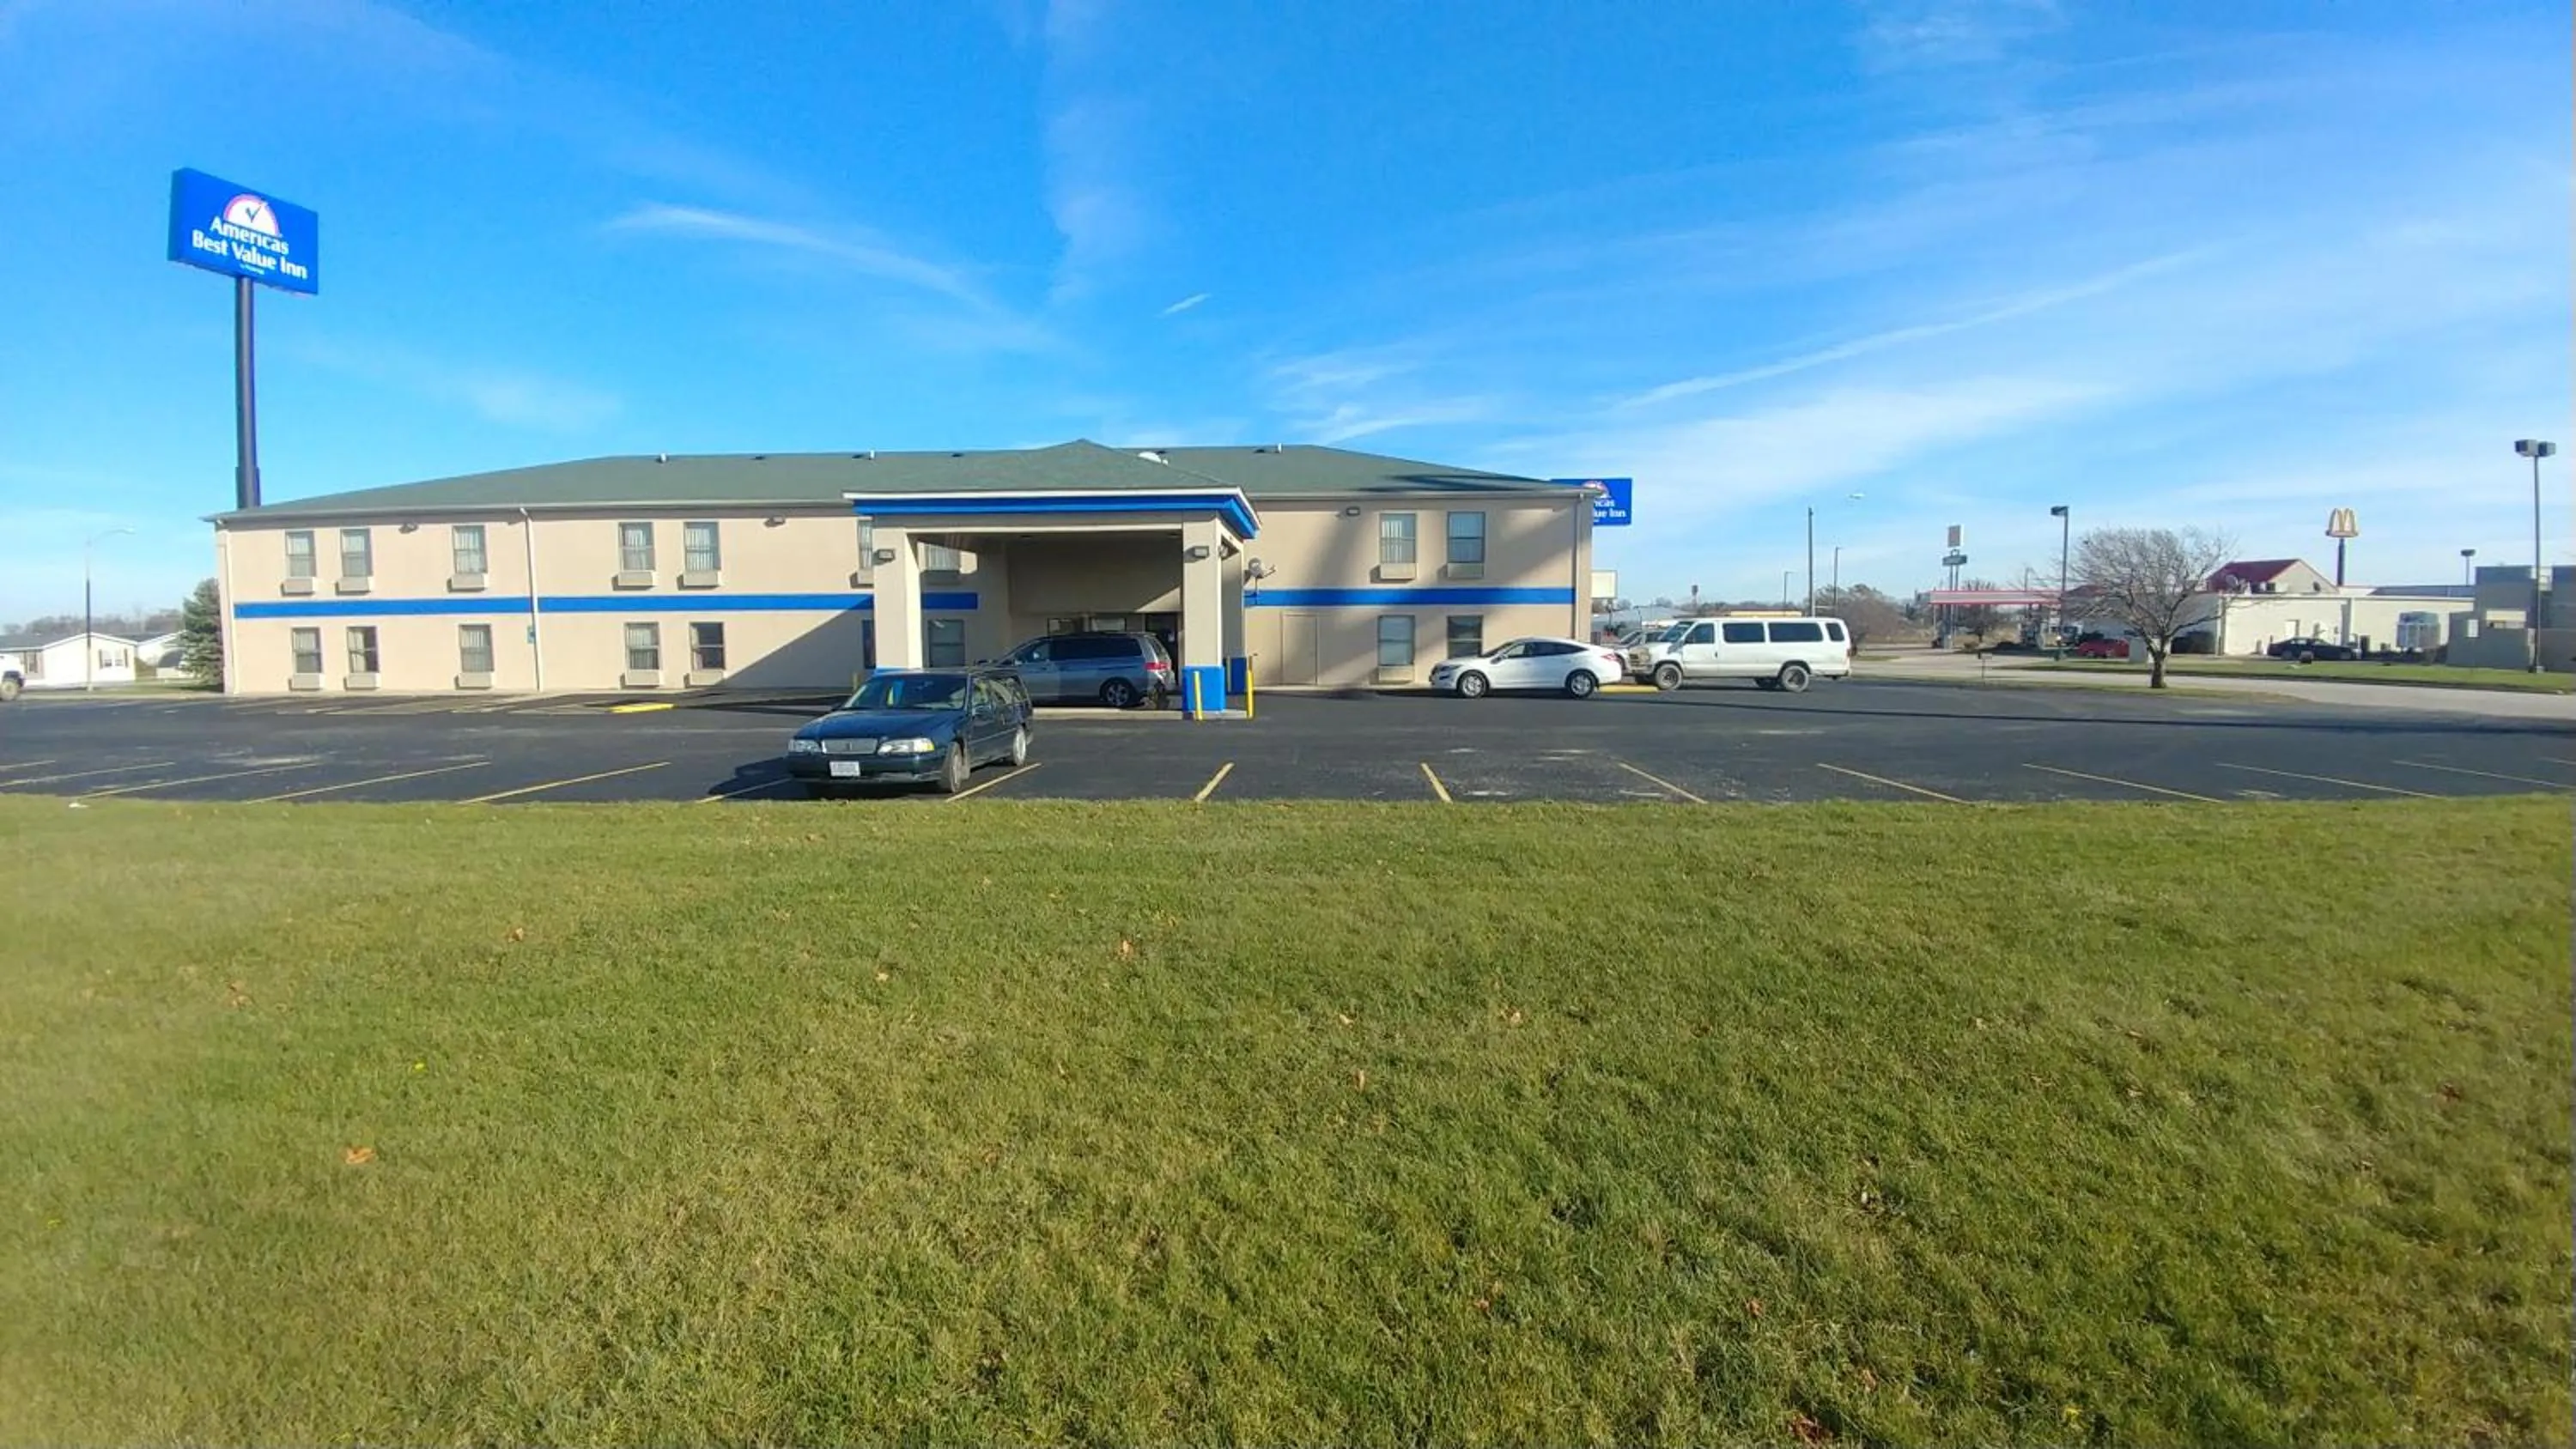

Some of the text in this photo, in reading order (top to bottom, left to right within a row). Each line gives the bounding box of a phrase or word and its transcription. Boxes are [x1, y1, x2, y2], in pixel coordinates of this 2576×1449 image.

[191, 229, 228, 256] Best
[232, 241, 276, 270] Value
[280, 257, 307, 279] Inn
[210, 215, 289, 255] Americas
[1608, 507, 1626, 518] Inn
